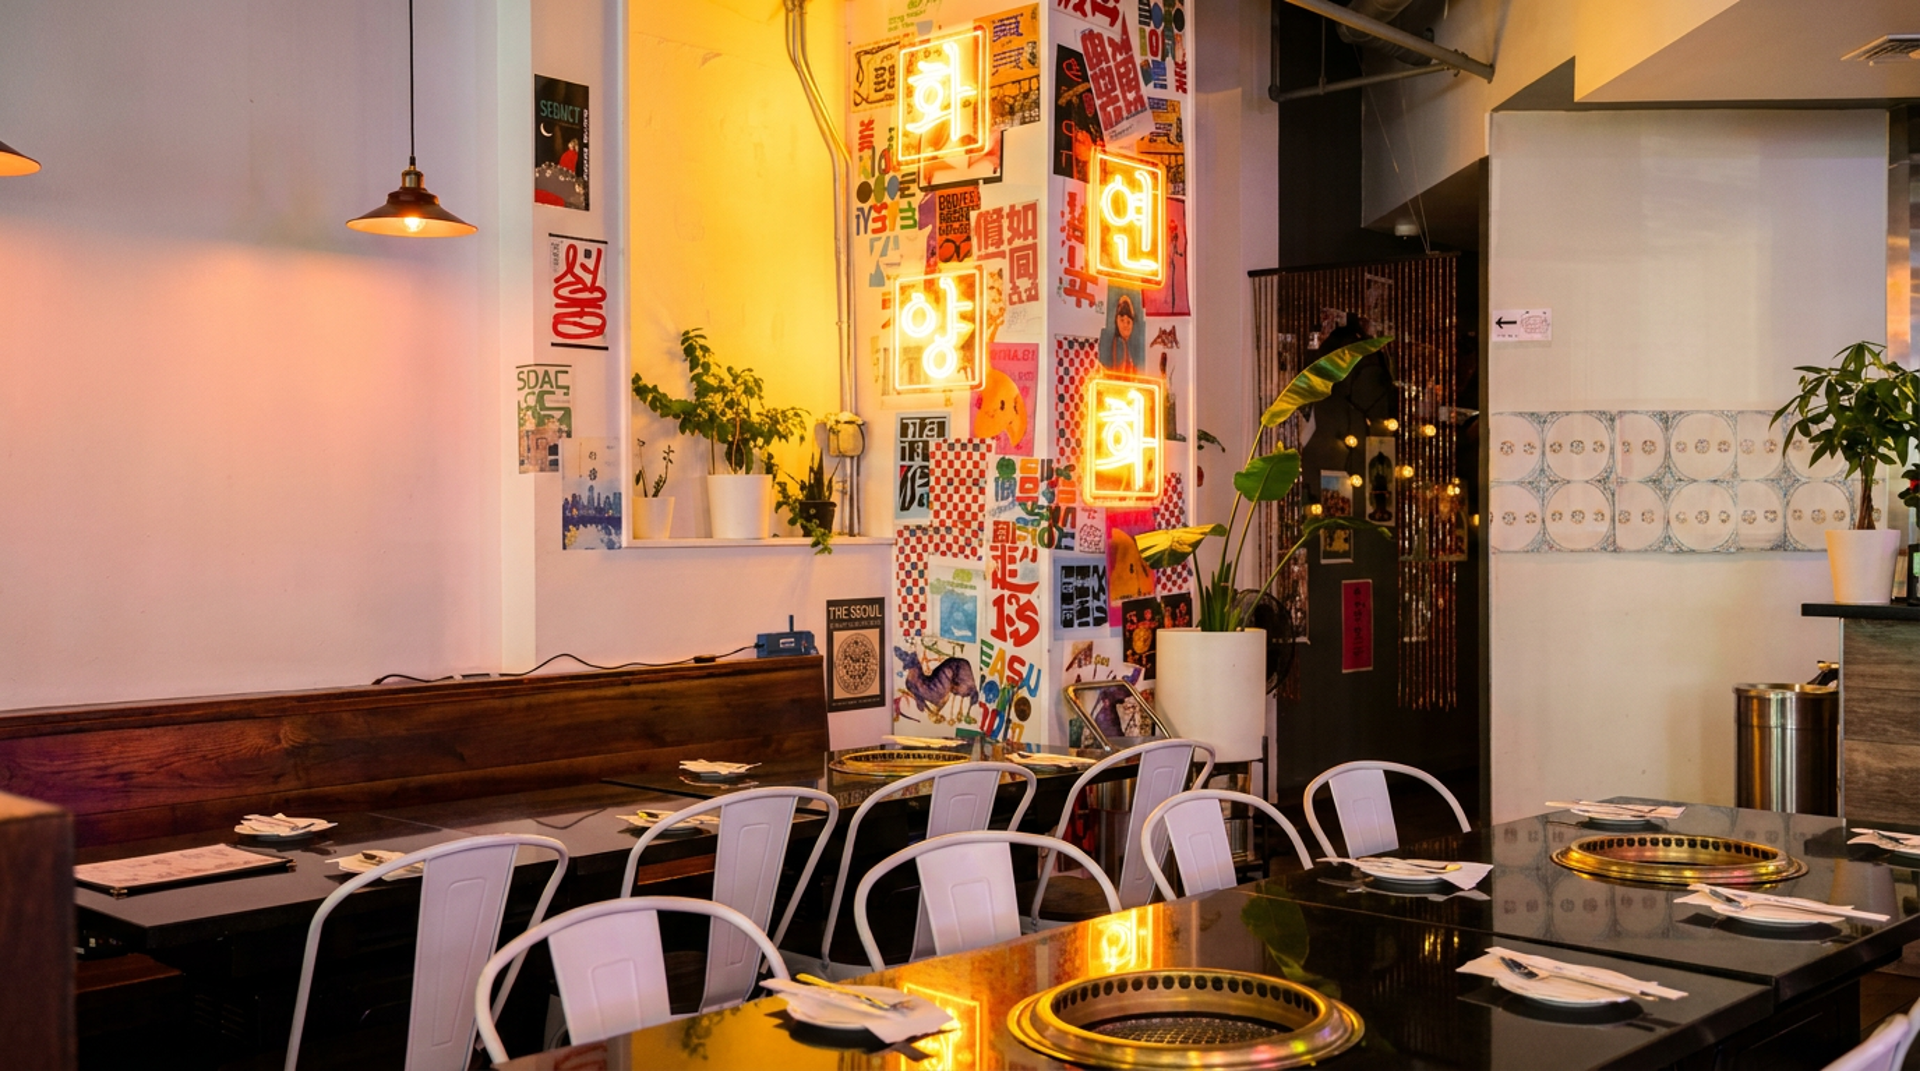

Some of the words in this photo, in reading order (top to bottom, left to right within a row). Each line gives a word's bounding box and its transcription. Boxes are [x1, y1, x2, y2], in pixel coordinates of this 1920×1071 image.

[905, 40, 977, 141] 화
[1101, 170, 1159, 270] 연
[901, 275, 975, 378] 양
[1095, 388, 1157, 492] 화
[828, 606, 849, 620] THE
